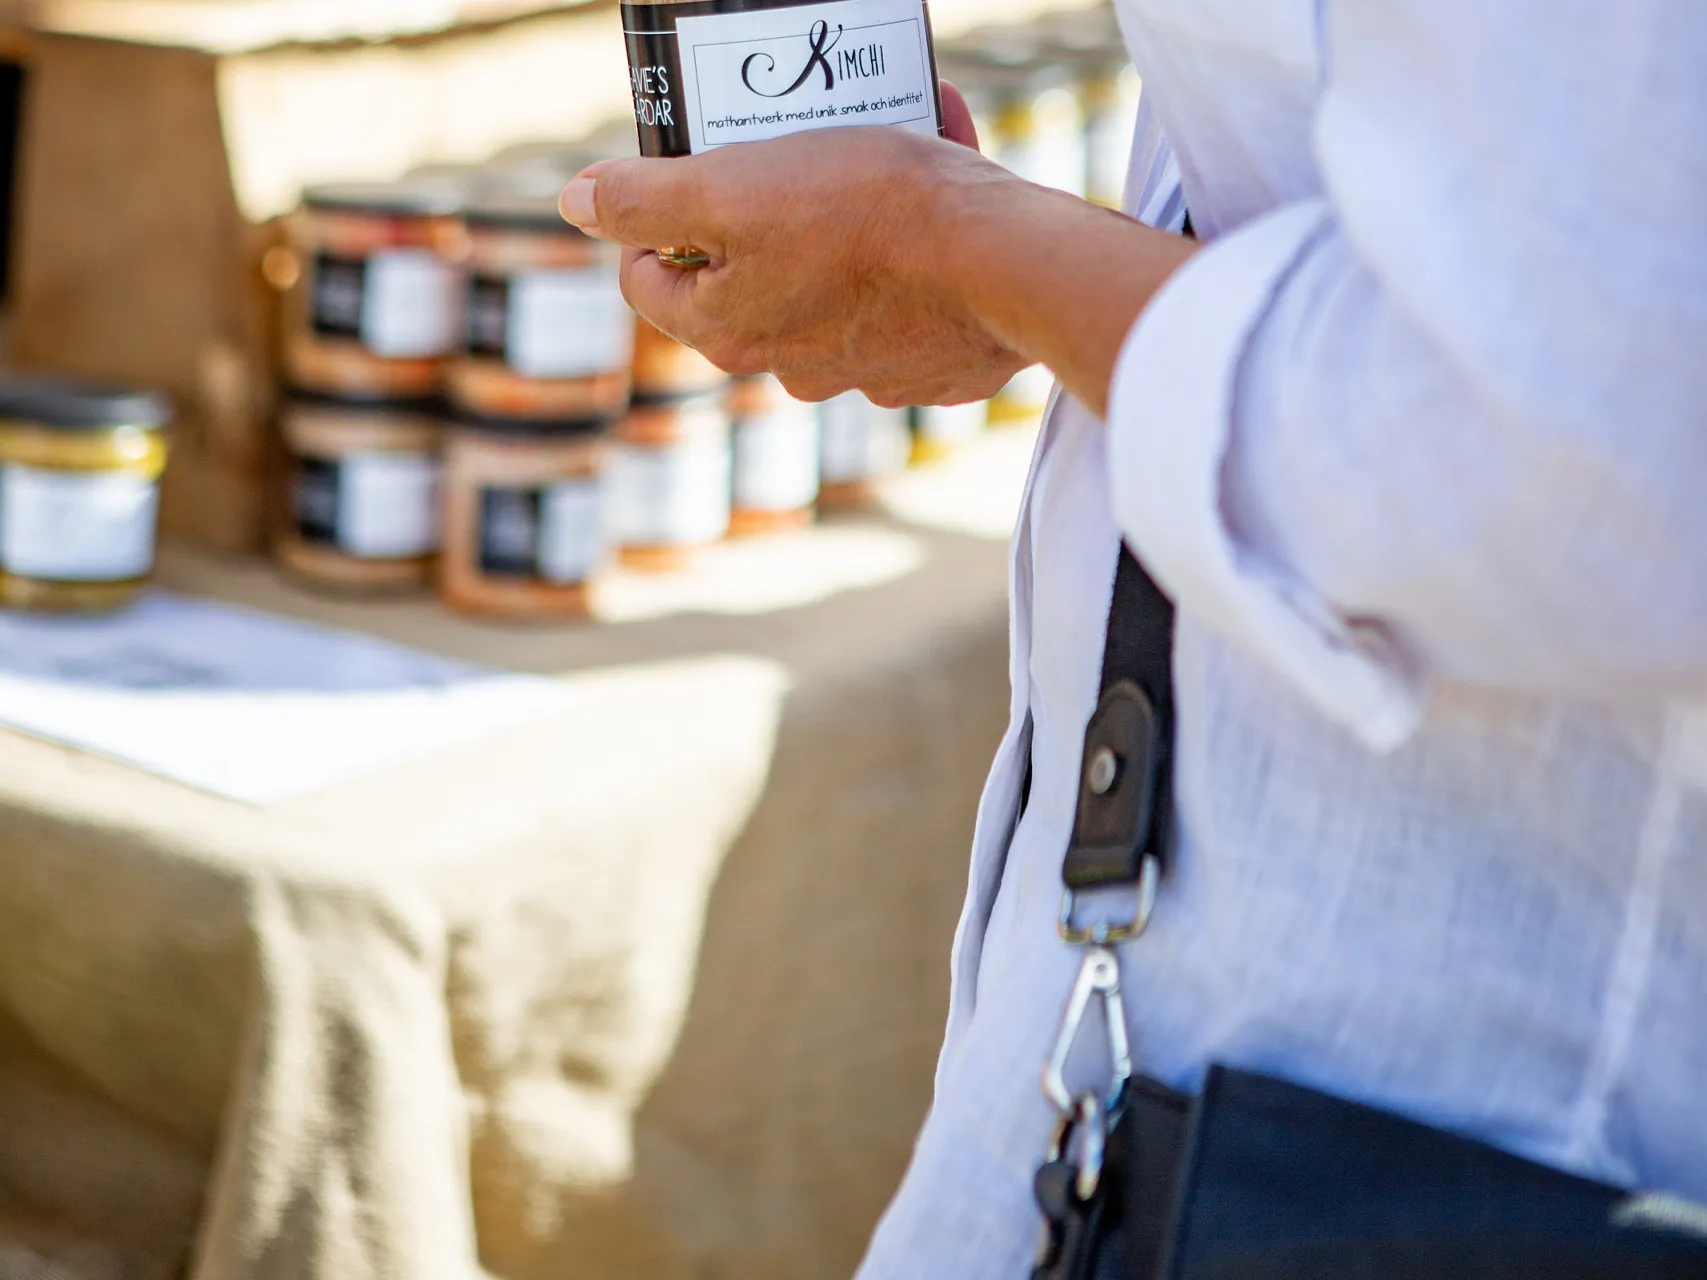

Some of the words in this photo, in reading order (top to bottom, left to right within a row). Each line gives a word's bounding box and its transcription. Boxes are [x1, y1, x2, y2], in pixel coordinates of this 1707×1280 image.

[707, 110, 784, 129] mathantverk
[785, 107, 814, 121] med
[815, 104, 838, 118] unik
[840, 100, 869, 116] smak
[870, 97, 888, 111] och
[888, 90, 923, 108] identitet
